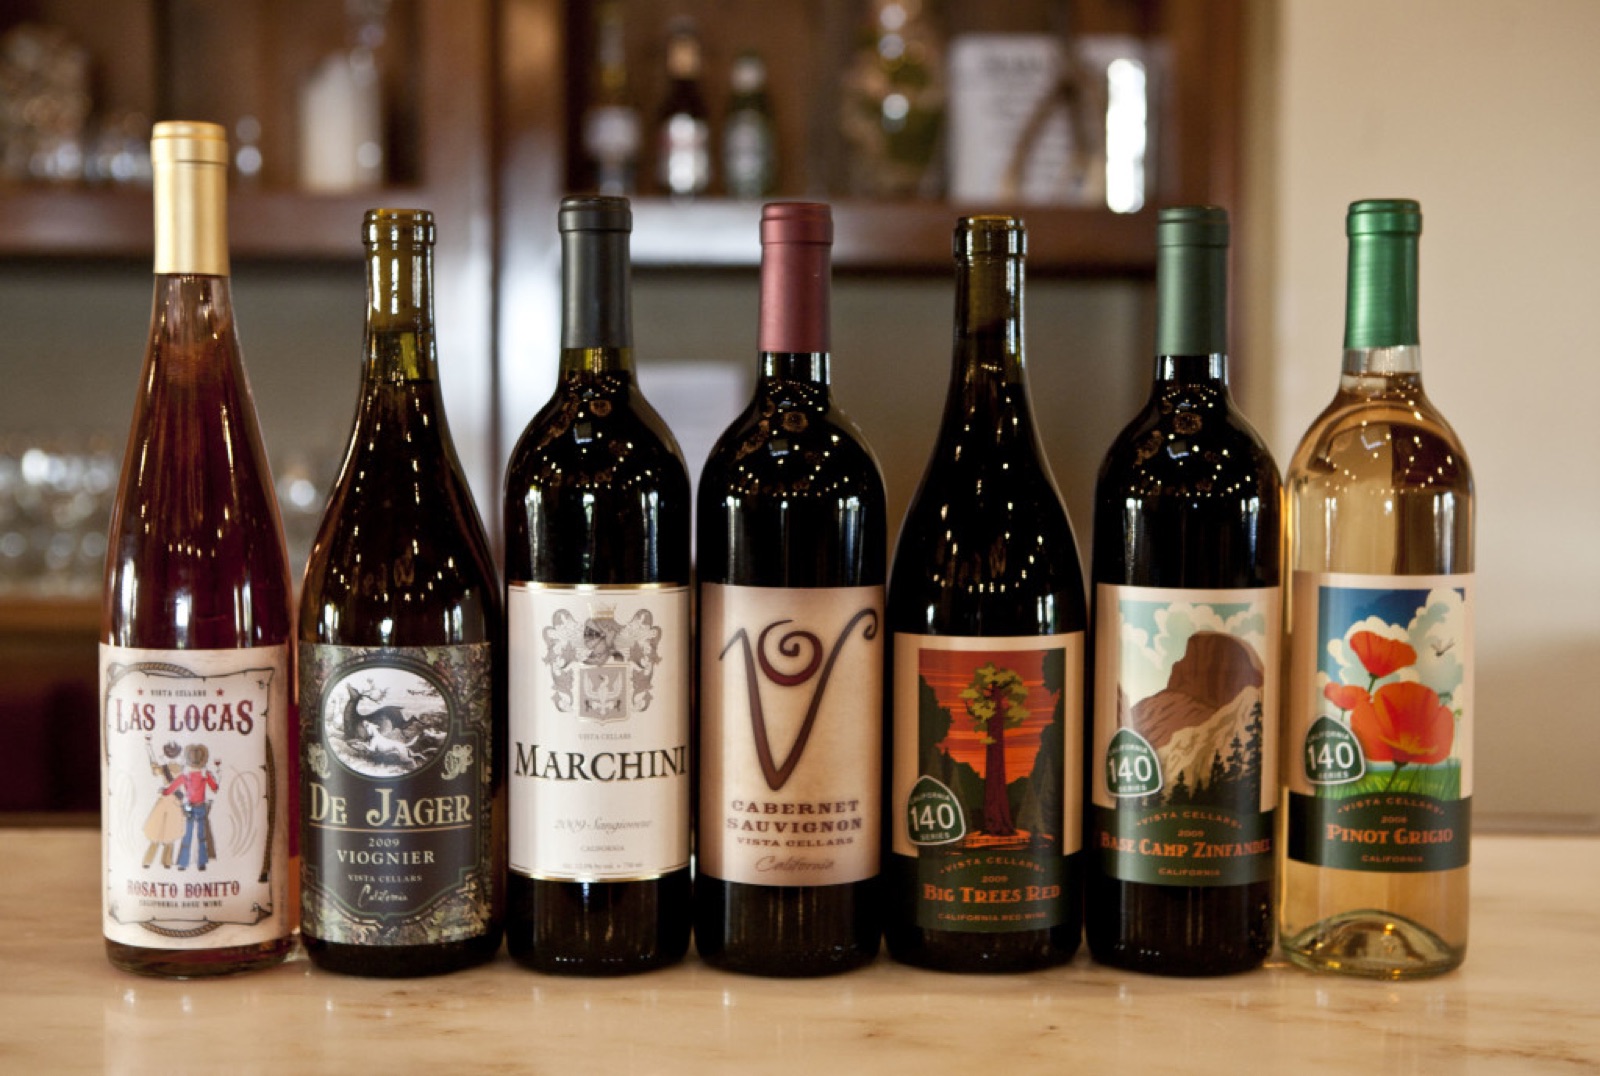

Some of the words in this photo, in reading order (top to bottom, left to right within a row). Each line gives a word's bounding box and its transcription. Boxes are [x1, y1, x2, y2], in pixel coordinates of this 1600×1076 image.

[116, 698, 156, 734] LAS
[168, 699, 254, 735] LOCAS
[514, 741, 688, 782] MARCHINI
[1308, 742, 1354, 770] 140
[1109, 755, 1152, 784] 140
[309, 782, 348, 824] DE
[365, 788, 473, 827] JAGER
[732, 799, 860, 815] CABERNET
[727, 817, 862, 834] SAUVIGNON
[910, 803, 955, 831] 140
[368, 838, 401, 848] 2009
[737, 837, 780, 847] VISTA
[785, 836, 854, 848] CELLARS
[1326, 823, 1390, 844] PINOT
[1393, 827, 1454, 845] GRIGIO
[1139, 839, 1188, 856] CAMP
[336, 849, 435, 866] VIOGNIER
[347, 874, 376, 882] VISTA
[378, 874, 423, 883] CELLARS
[1158, 868, 1220, 876] CALIFORNIA
[127, 879, 178, 898] ROSATO
[185, 880, 240, 898] BONITO
[923, 883, 956, 902] BIG
[958, 886, 1022, 904] TREES
[1025, 885, 1062, 902] RED
[938, 913, 998, 921] CALIFORNIA
